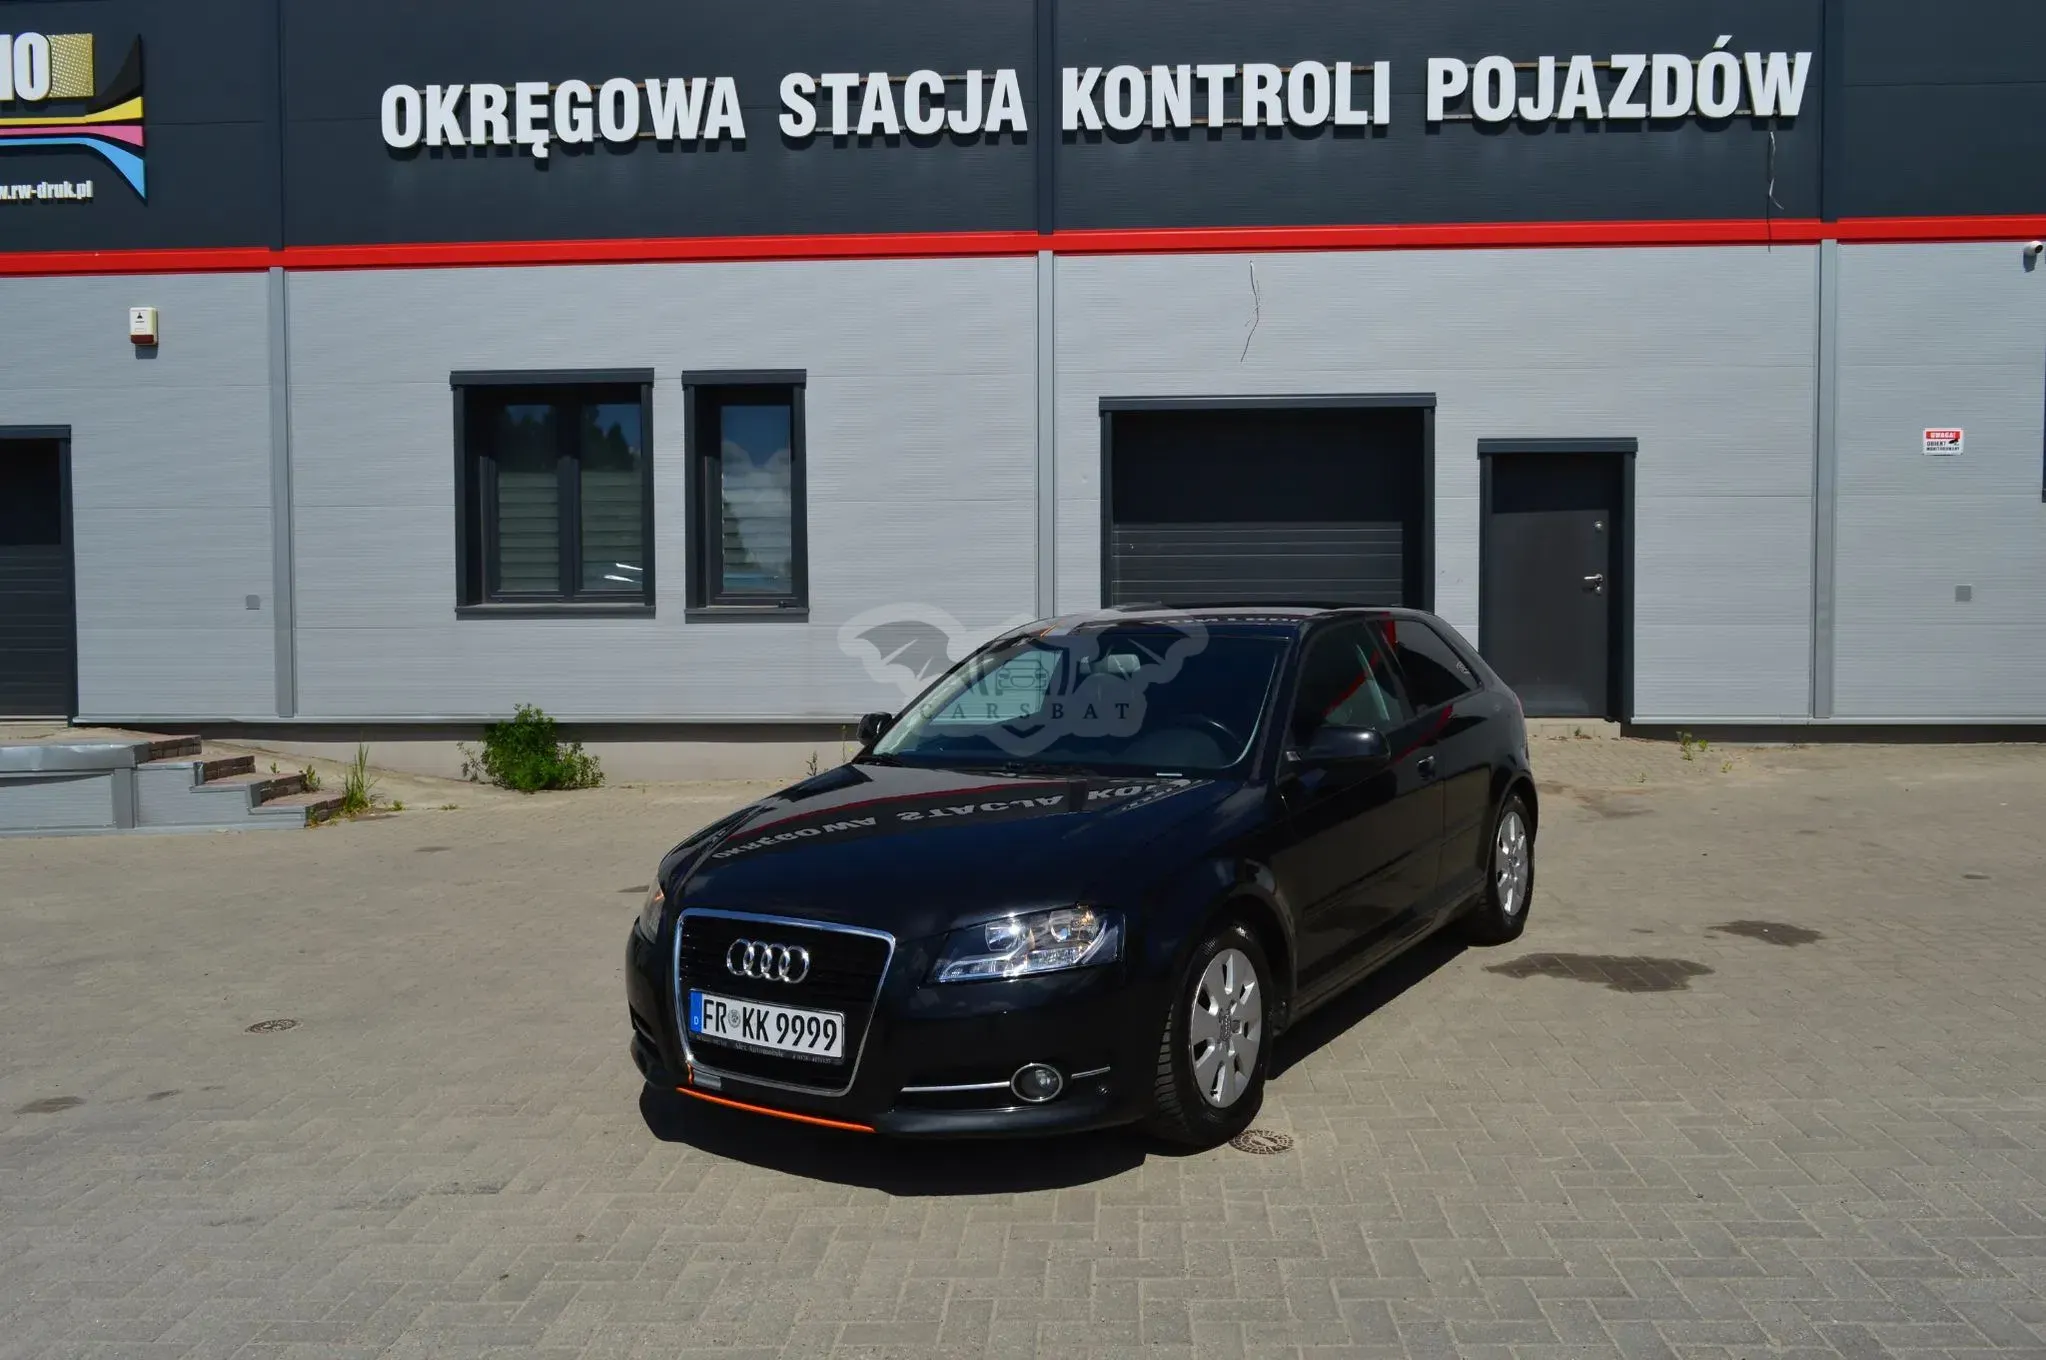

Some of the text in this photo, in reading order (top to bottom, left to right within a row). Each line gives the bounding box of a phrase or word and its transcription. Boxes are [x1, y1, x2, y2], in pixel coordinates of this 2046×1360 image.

[381, 35, 1812, 158] OKRĘGOWA STACJA KONTROLI POJAZDÓW
[693, 1016, 700, 1026] D
[703, 1000, 837, 1051] FR KK 9999
